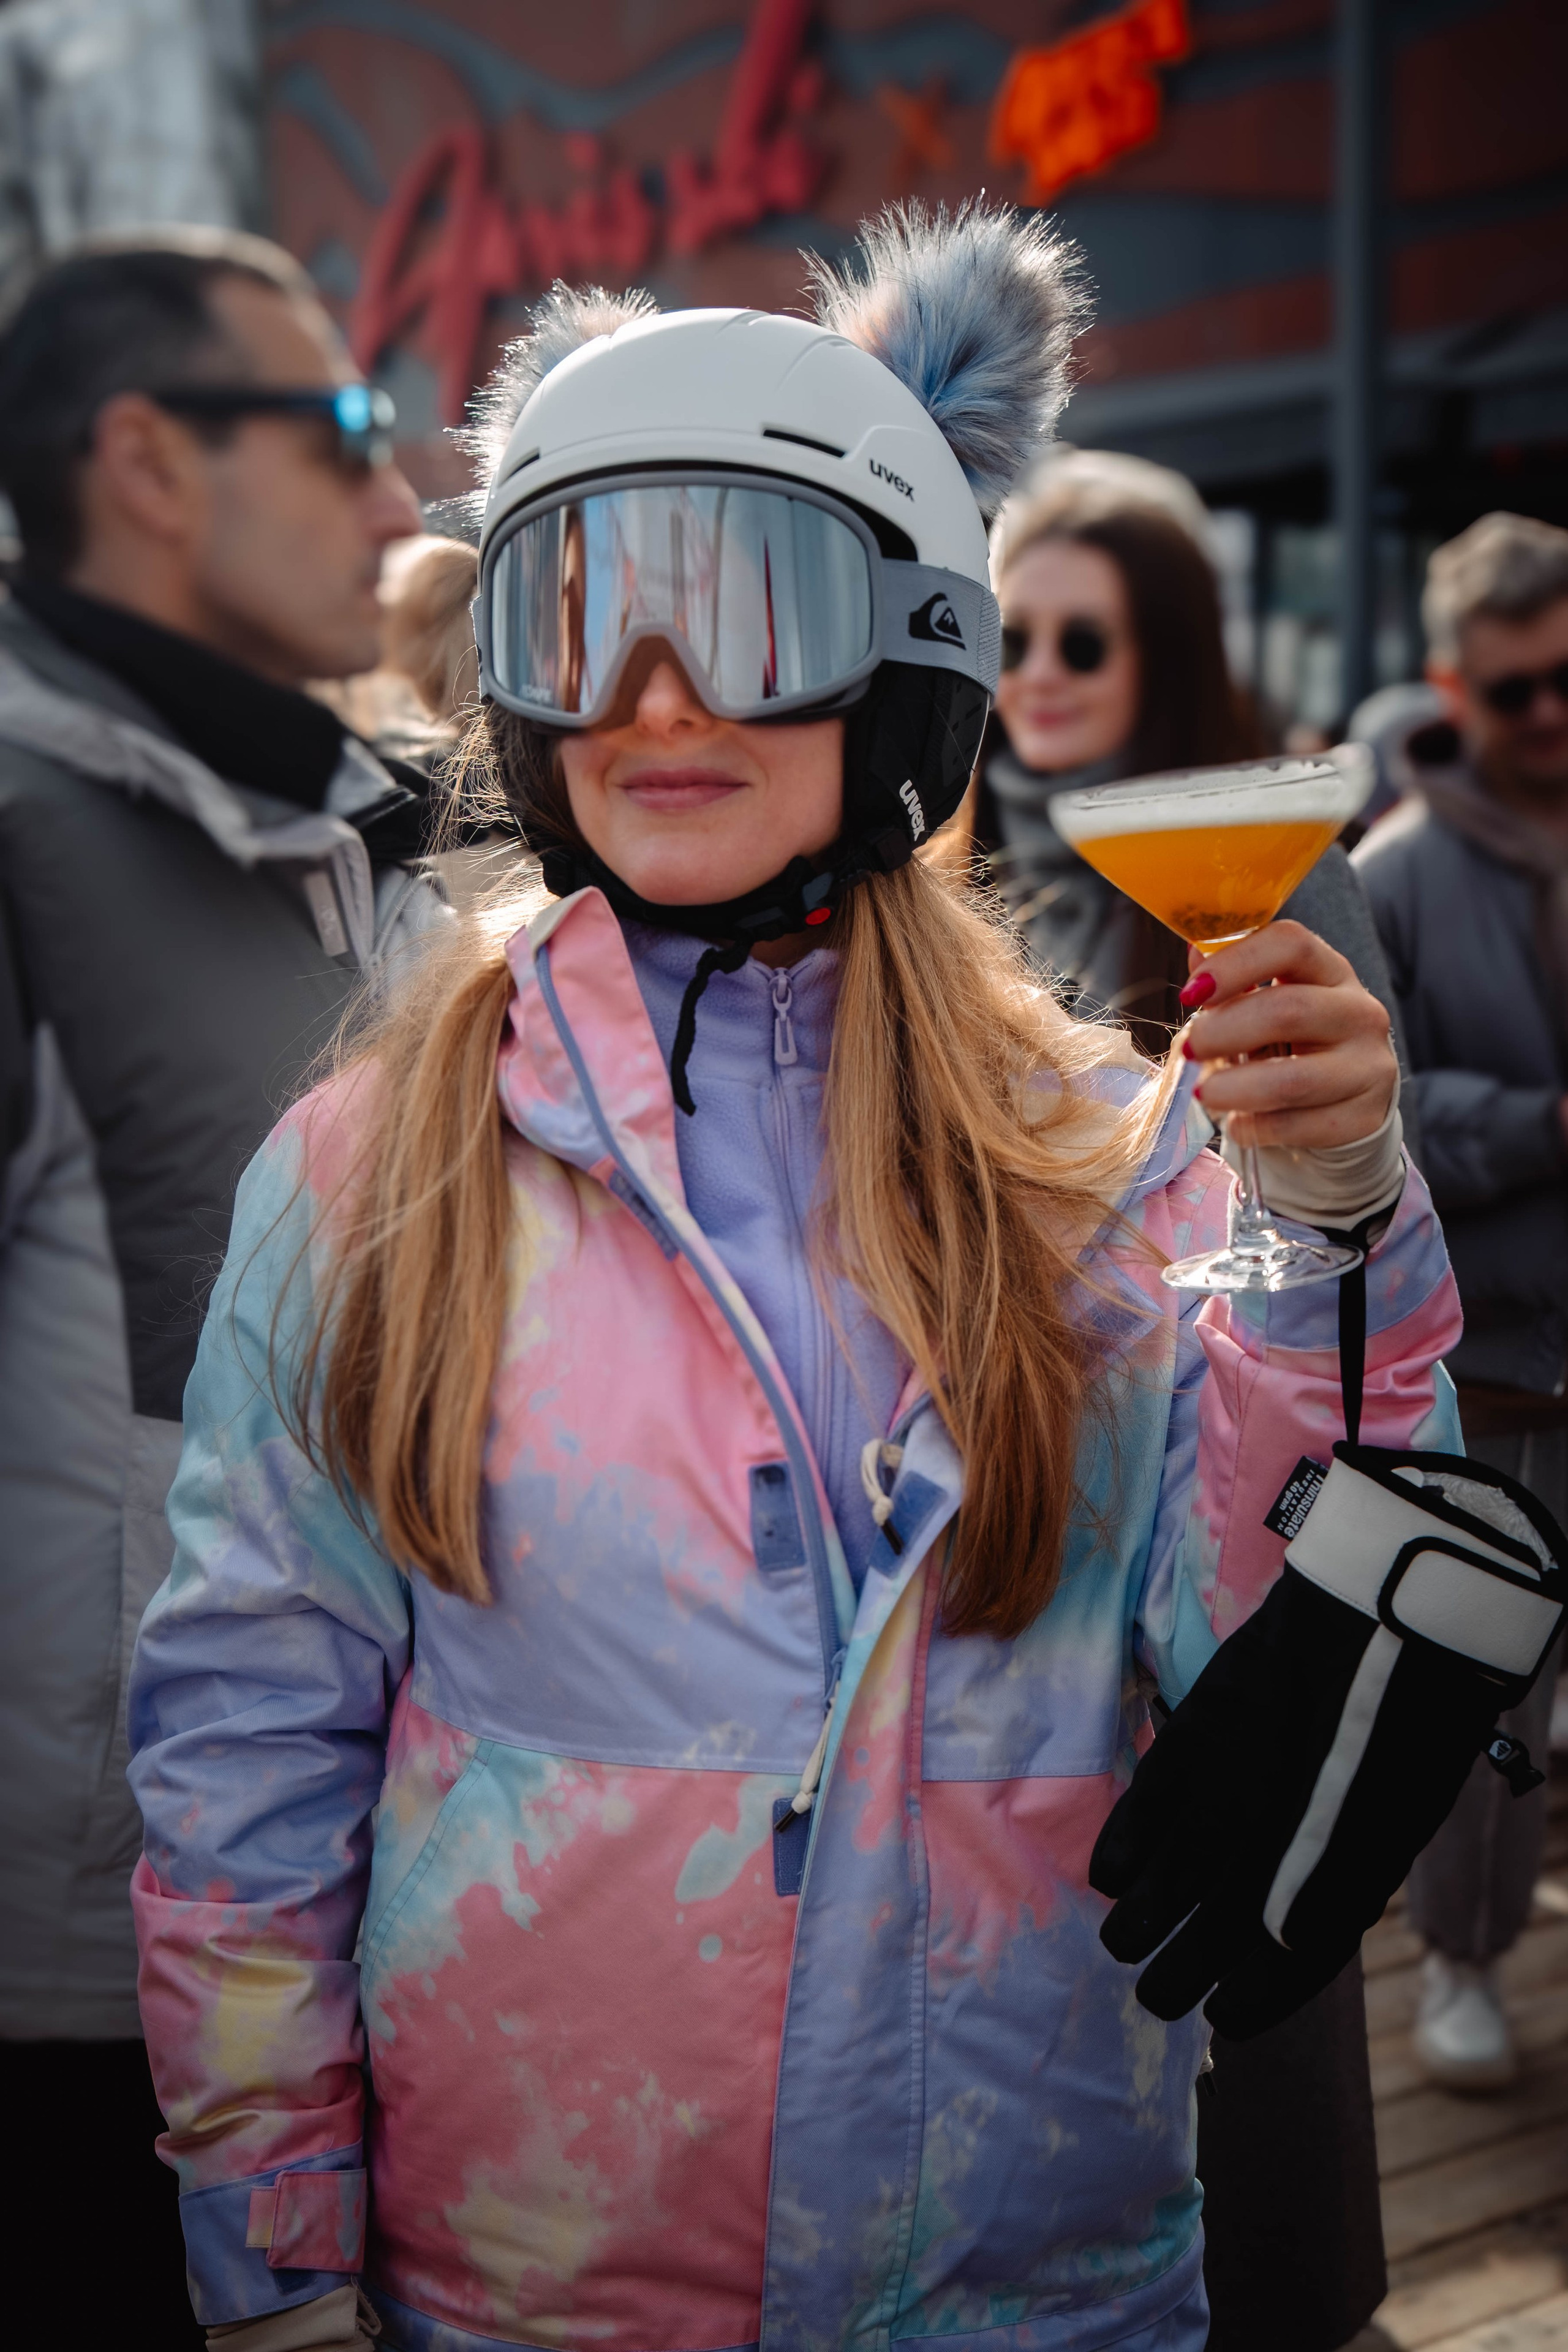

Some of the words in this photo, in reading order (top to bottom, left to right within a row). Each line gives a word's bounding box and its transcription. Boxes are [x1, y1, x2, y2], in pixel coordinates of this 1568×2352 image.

[869, 458, 914, 503] uvex
[899, 779, 925, 842] uvex
[1277, 1469, 1315, 1531] INSULATION
[1279, 1490, 1294, 1510] gram
[1289, 1481, 1300, 1493] 40
